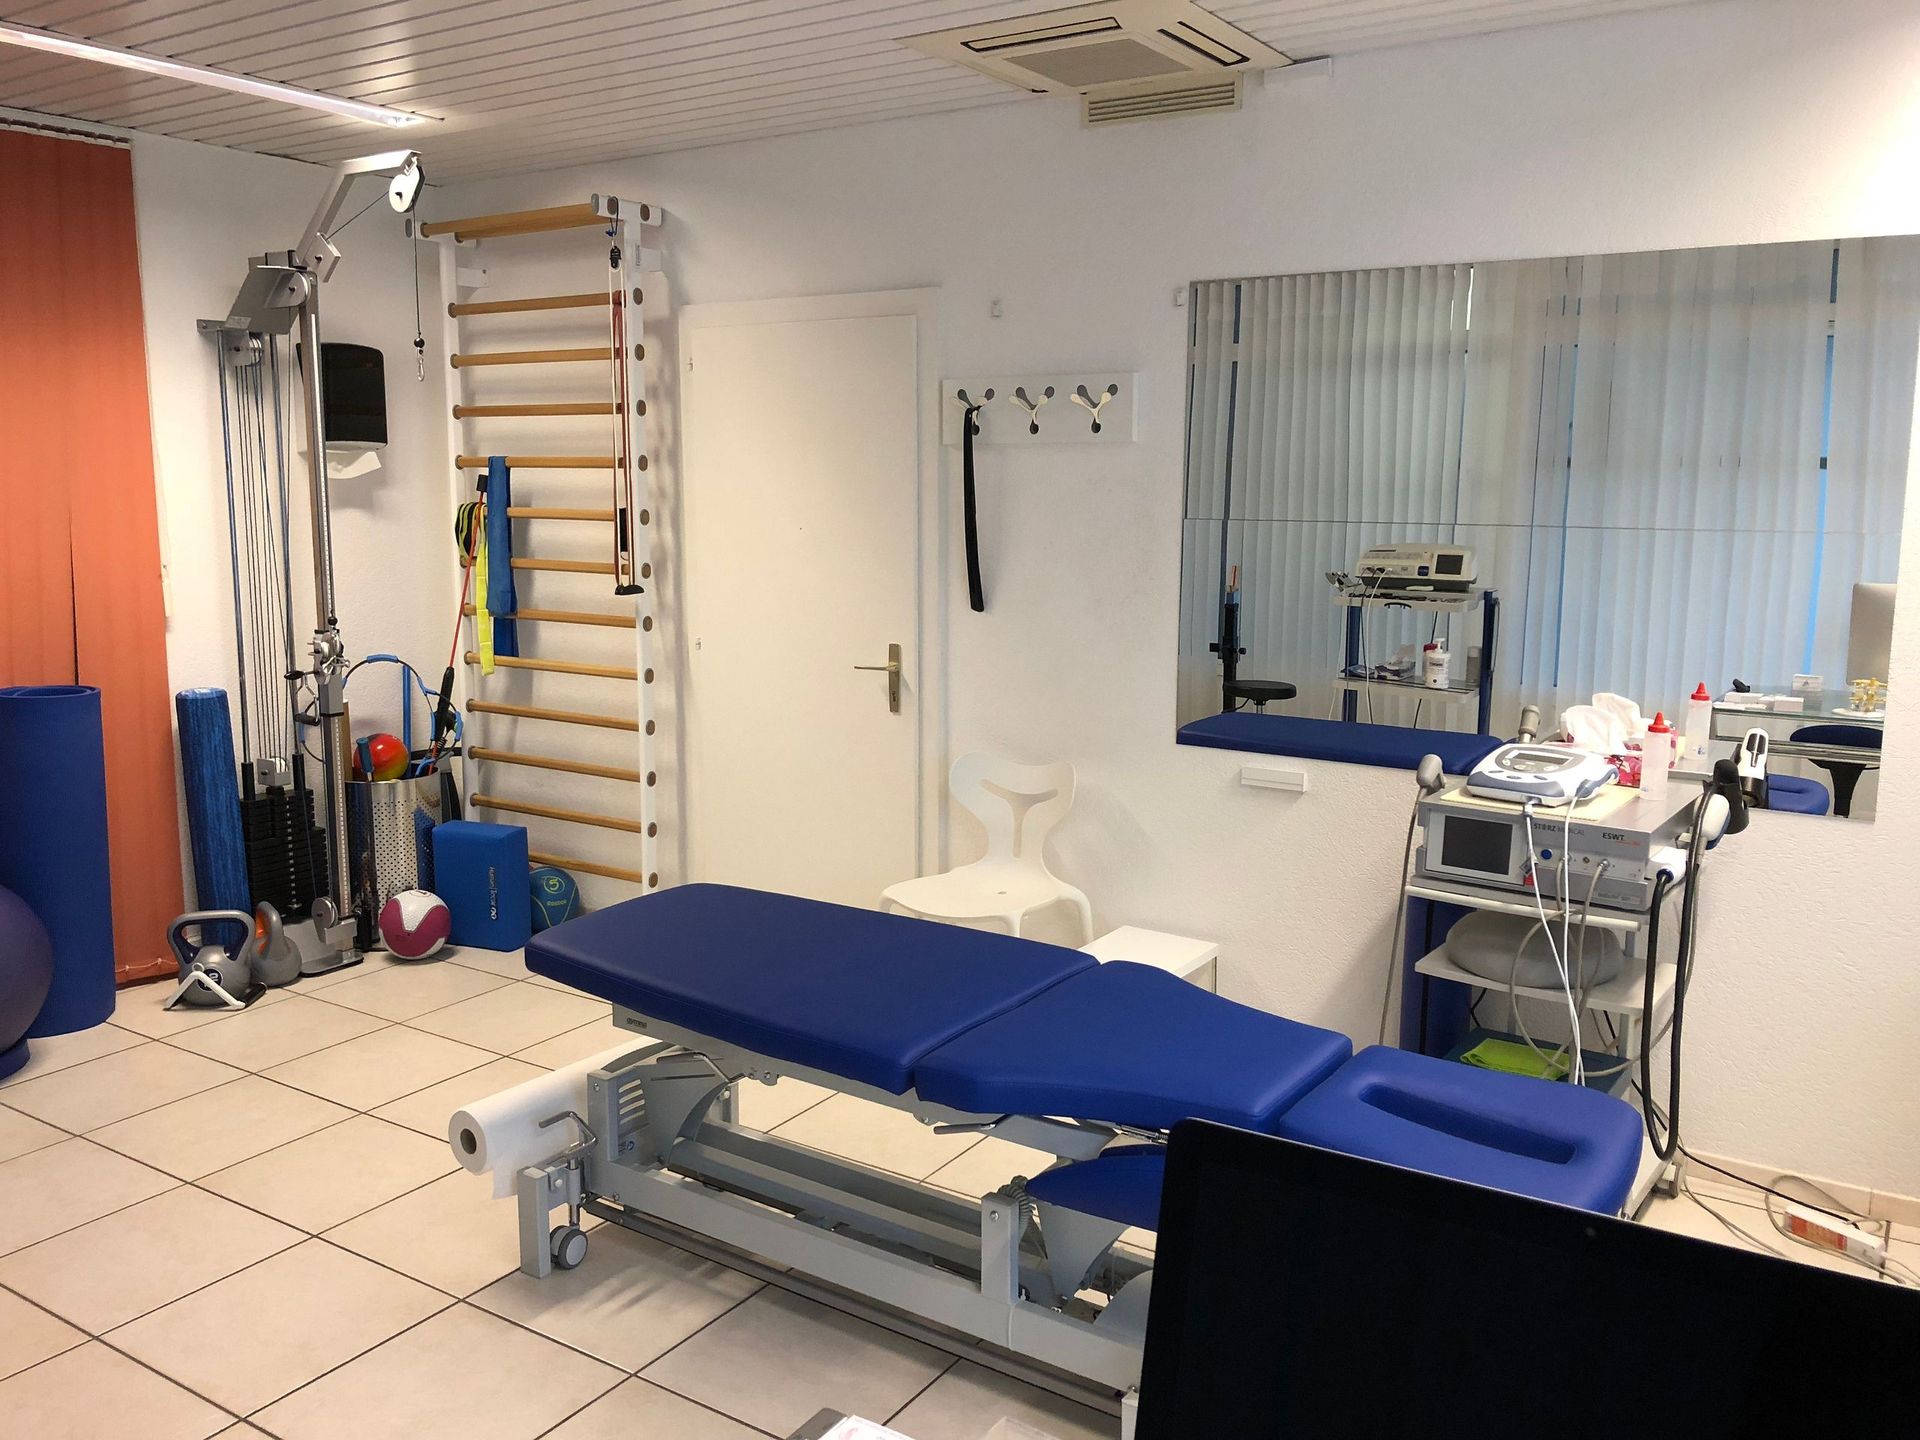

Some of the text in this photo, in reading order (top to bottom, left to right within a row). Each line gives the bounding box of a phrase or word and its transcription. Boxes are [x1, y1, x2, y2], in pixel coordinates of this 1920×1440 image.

[1533, 822, 1556, 832] STORZ
[1602, 831, 1625, 841] ESWT
[548, 878, 559, 891] 5
